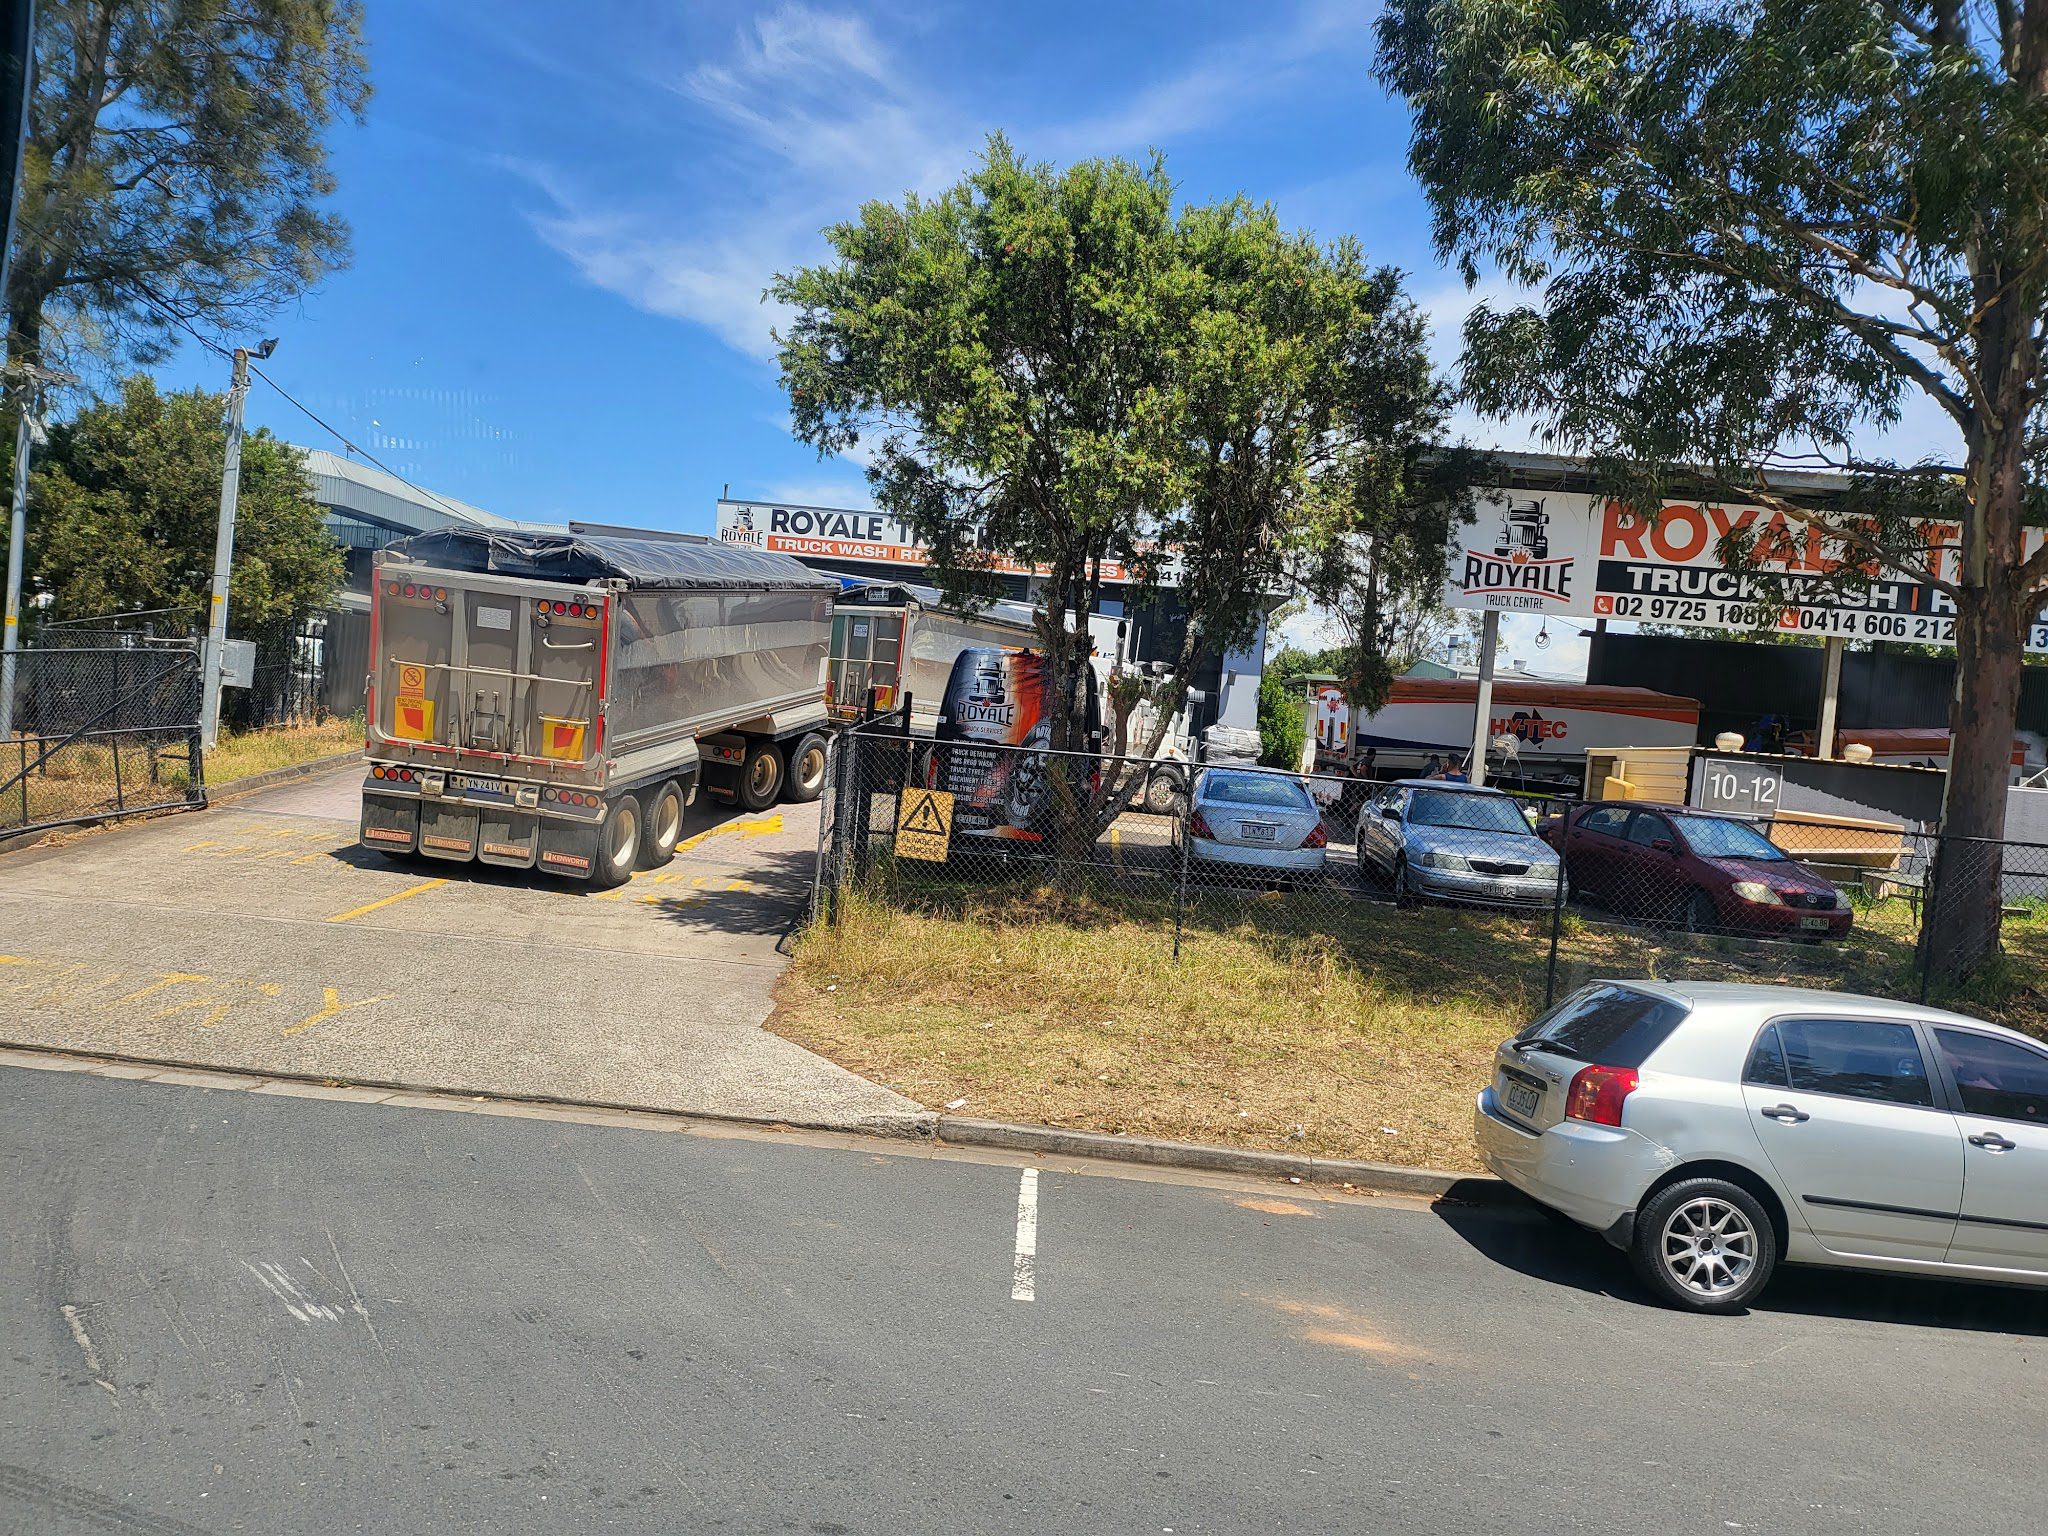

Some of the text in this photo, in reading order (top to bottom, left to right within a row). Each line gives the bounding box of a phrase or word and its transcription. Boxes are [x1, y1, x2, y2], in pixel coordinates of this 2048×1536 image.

[770, 509, 883, 541] ROYALE
[721, 529, 763, 546] ROYALE
[775, 538, 833, 553] TRUCK
[838, 545, 887, 558] WASH
[1464, 555, 1574, 598] ROYALE
[1627, 566, 1766, 599] TRUCK
[1780, 576, 1899, 610] WASH
[1486, 594, 1544, 609] TRUCK CENTRE
[1615, 596, 1643, 616] 02
[1650, 599, 1707, 622] 9725
[1800, 610, 1856, 633] 0414
[1864, 614, 1906, 638] 606
[1914, 618, 1956, 641] 212
[957, 702, 1015, 726] ROYALE
[981, 726, 1003, 735] SERVICES
[1490, 719, 1567, 738] HY-TEC
[968, 767, 985, 775] TYRES
[1710, 773, 1776, 803] 10-12
[374, 831, 412, 841] KENWORTH
[432, 837, 471, 849] KENWORTH
[493, 845, 529, 857] KENWORTH
[551, 853, 589, 866] KENWORTH
